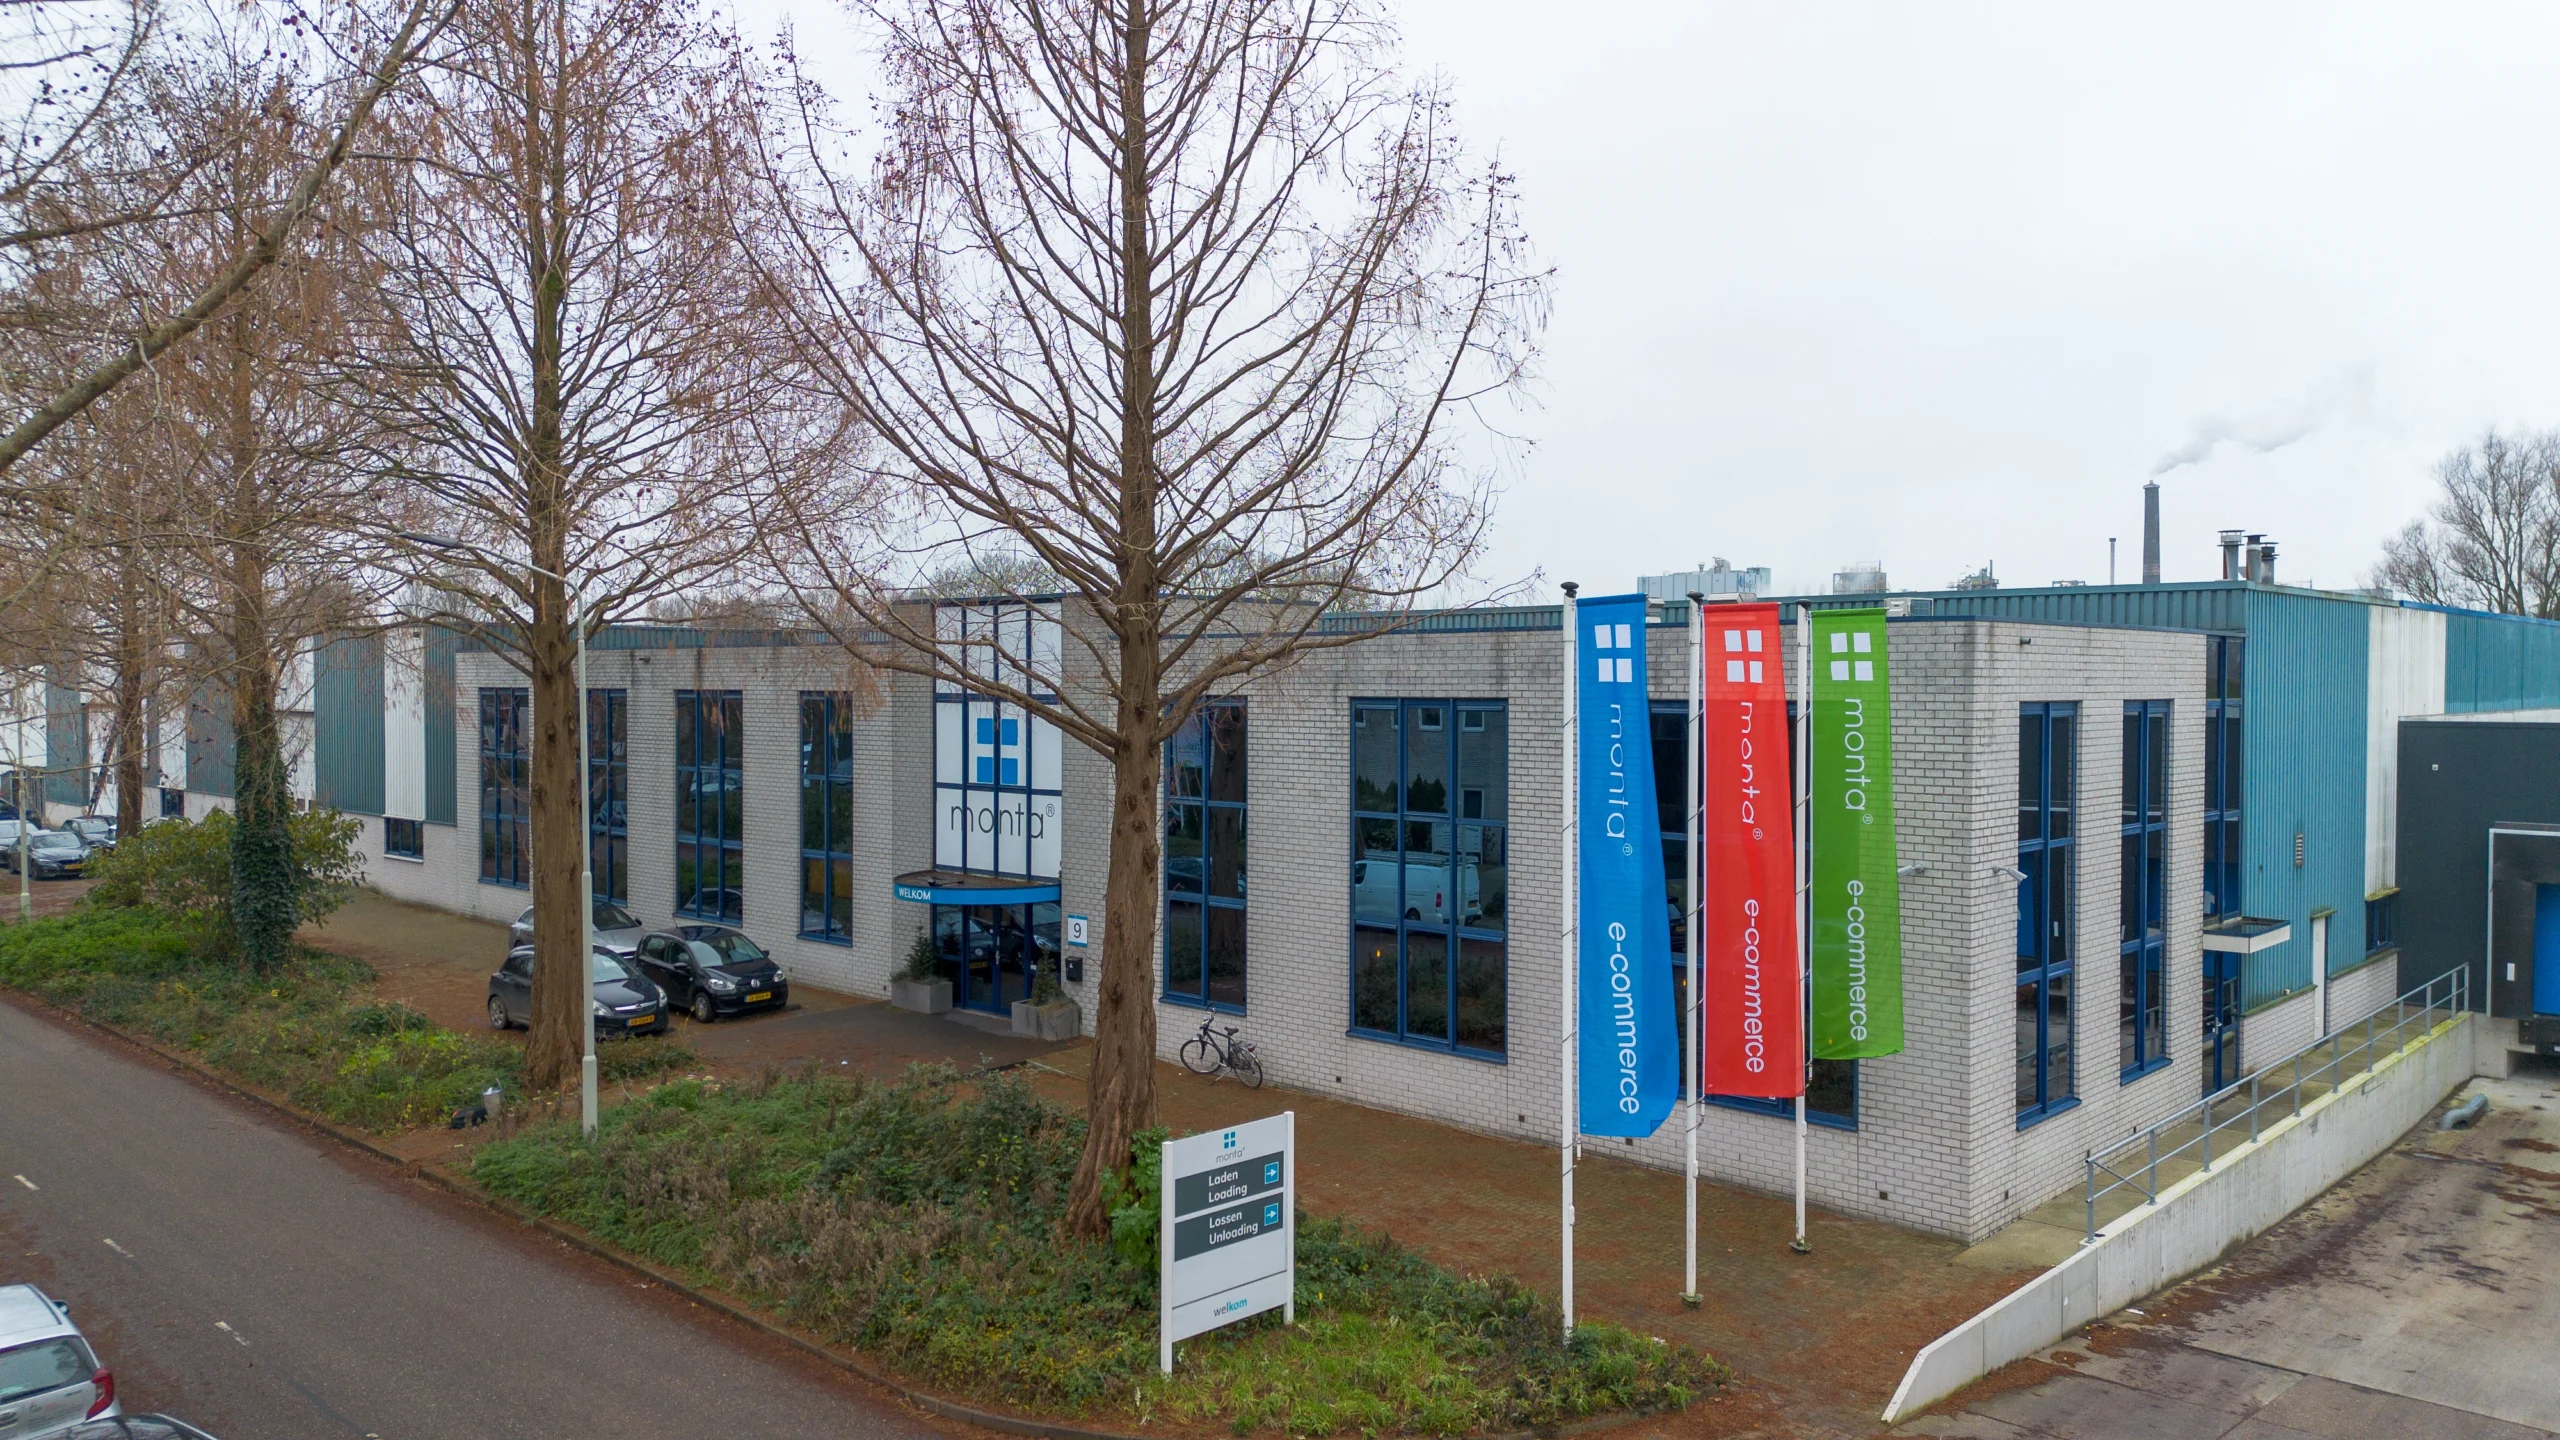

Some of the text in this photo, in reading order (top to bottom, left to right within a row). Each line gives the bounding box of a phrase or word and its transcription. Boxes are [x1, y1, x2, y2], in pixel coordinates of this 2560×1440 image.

[899, 887, 931, 900] WELKOM
[1073, 923, 1082, 939] 9
[1847, 879, 1868, 1042] e-commerce
[1744, 899, 1765, 1074] e-commerce
[1608, 922, 1640, 1115] e-commerce
[1208, 1171, 1239, 1187] Laden
[1208, 1184, 1248, 1203] Loading
[1209, 1212, 1242, 1229] Lossen
[1209, 1223, 1259, 1245] Unloading
[1213, 1299, 1248, 1317] welkom
